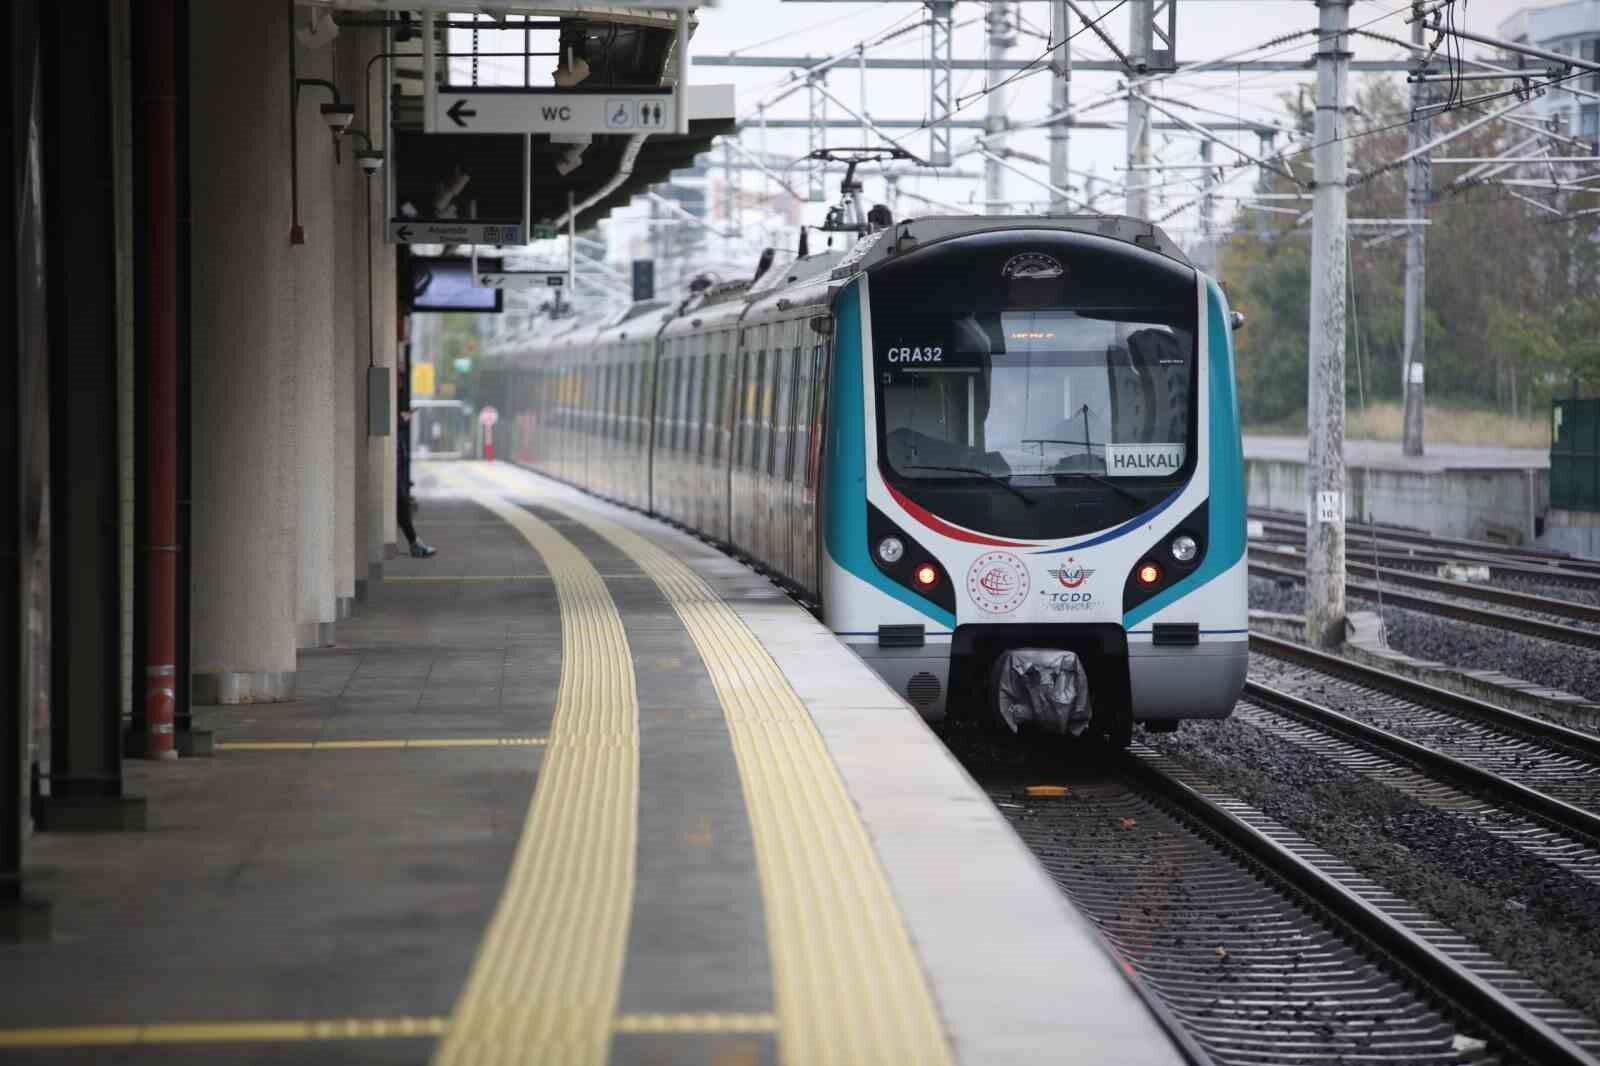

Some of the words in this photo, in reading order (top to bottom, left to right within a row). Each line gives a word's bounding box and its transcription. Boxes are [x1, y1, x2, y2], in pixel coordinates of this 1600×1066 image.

[541, 106, 571, 121] WC
[888, 347, 942, 362] CRA32
[1114, 453, 1180, 468] HALKALI
[1049, 592, 1092, 602] TCDD
